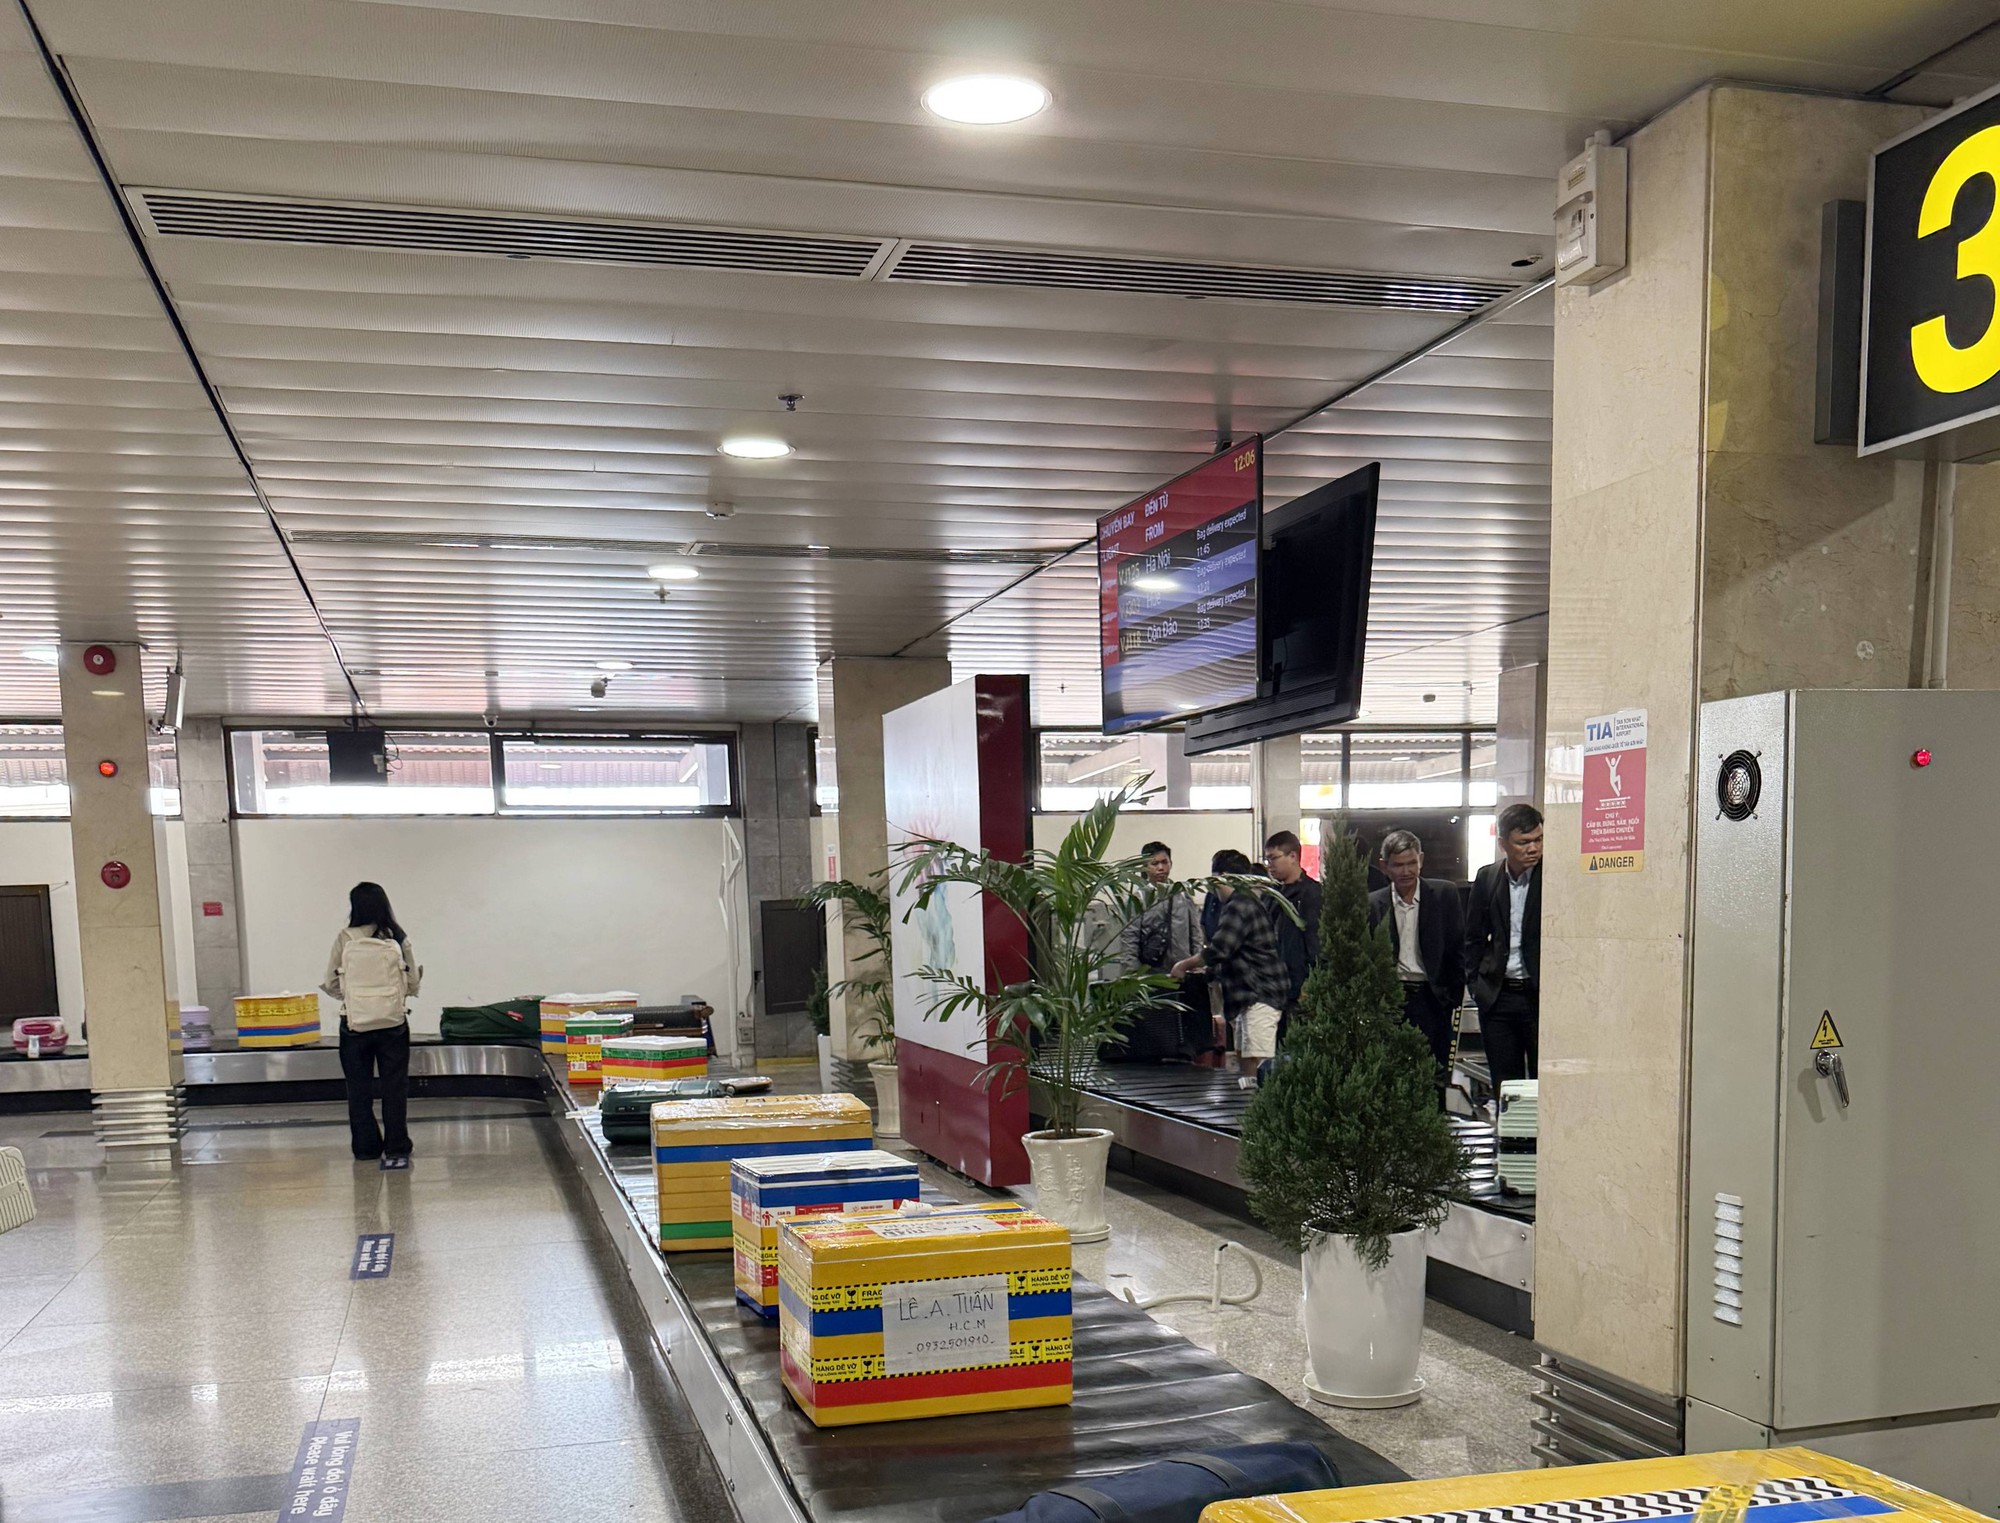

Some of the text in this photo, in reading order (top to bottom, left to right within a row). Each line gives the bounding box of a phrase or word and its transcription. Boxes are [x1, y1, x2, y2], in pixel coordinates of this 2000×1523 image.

[1910, 124, 2000, 393] 3
[1234, 449, 1255, 472] 12:06
[1123, 511, 1135, 528] BAY
[1145, 521, 1164, 542] FROM
[1586, 722, 1612, 741] TIA
[1599, 856, 1634, 868] DANGER
[816, 1364, 834, 1372] HÀNG
[290, 1436, 328, 1514] Please wait here
